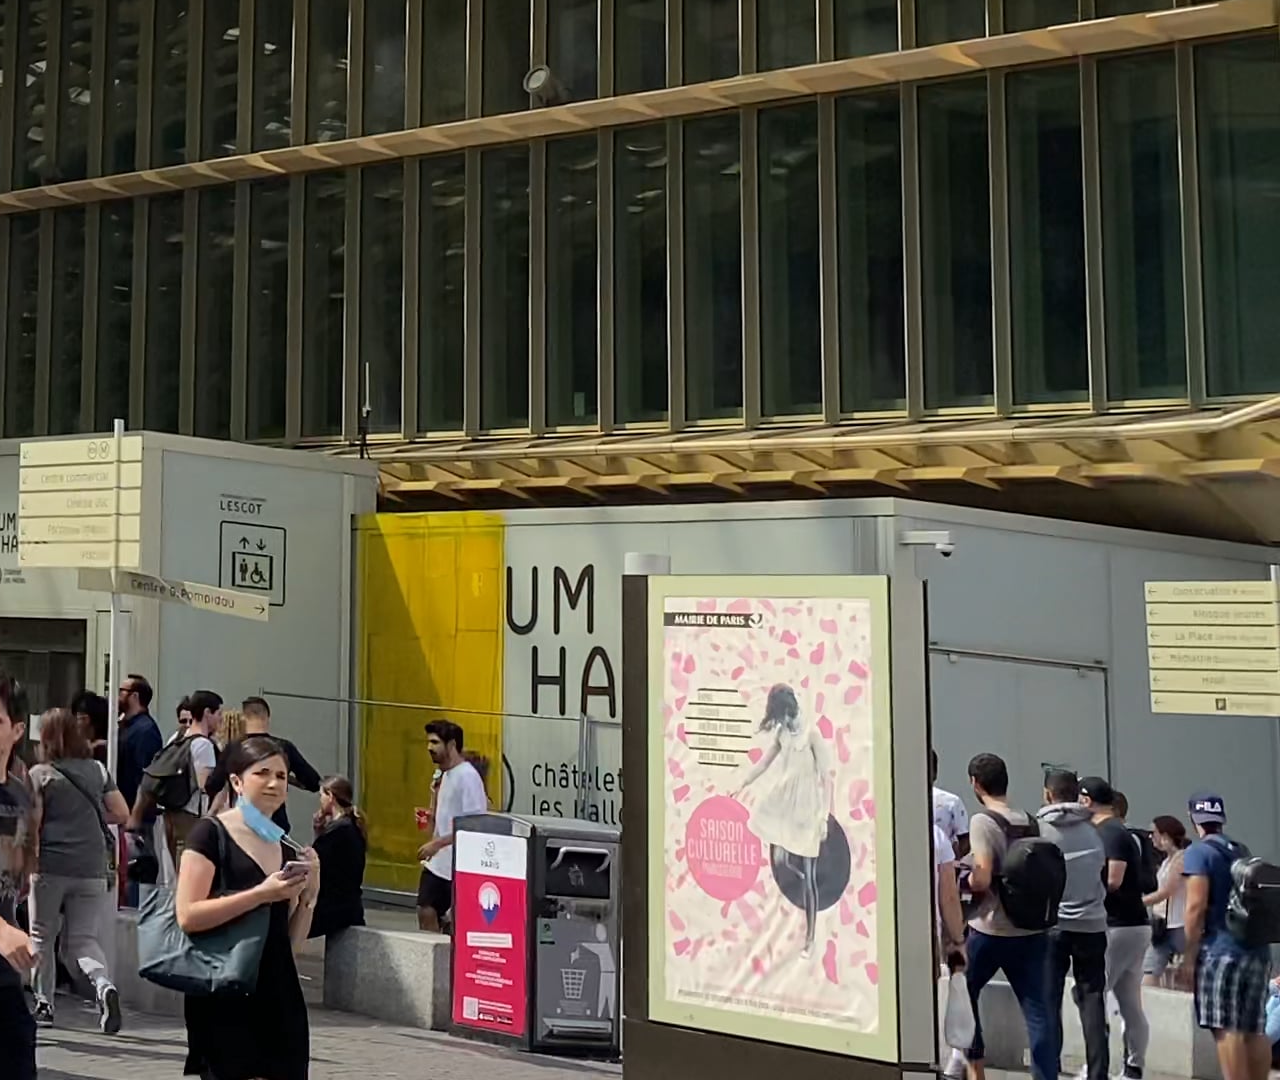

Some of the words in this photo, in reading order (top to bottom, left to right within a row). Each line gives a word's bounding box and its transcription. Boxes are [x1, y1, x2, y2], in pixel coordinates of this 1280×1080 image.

[220, 500, 262, 515] LESCOT
[131, 579, 166, 594] Centre
[181, 588, 235, 609] Pompidou
[506, 564, 594, 636] UM
[674, 615, 705, 625] MAIRIE
[706, 615, 719, 625] DE
[720, 615, 745, 626] PARIS
[531, 645, 616, 719] HA
[532, 762, 624, 792] Châtelet
[532, 794, 563, 818] les
[1195, 801, 1222, 812] FILA
[700, 818, 744, 842] SAISON
[687, 838, 757, 866] CULTURELLE
